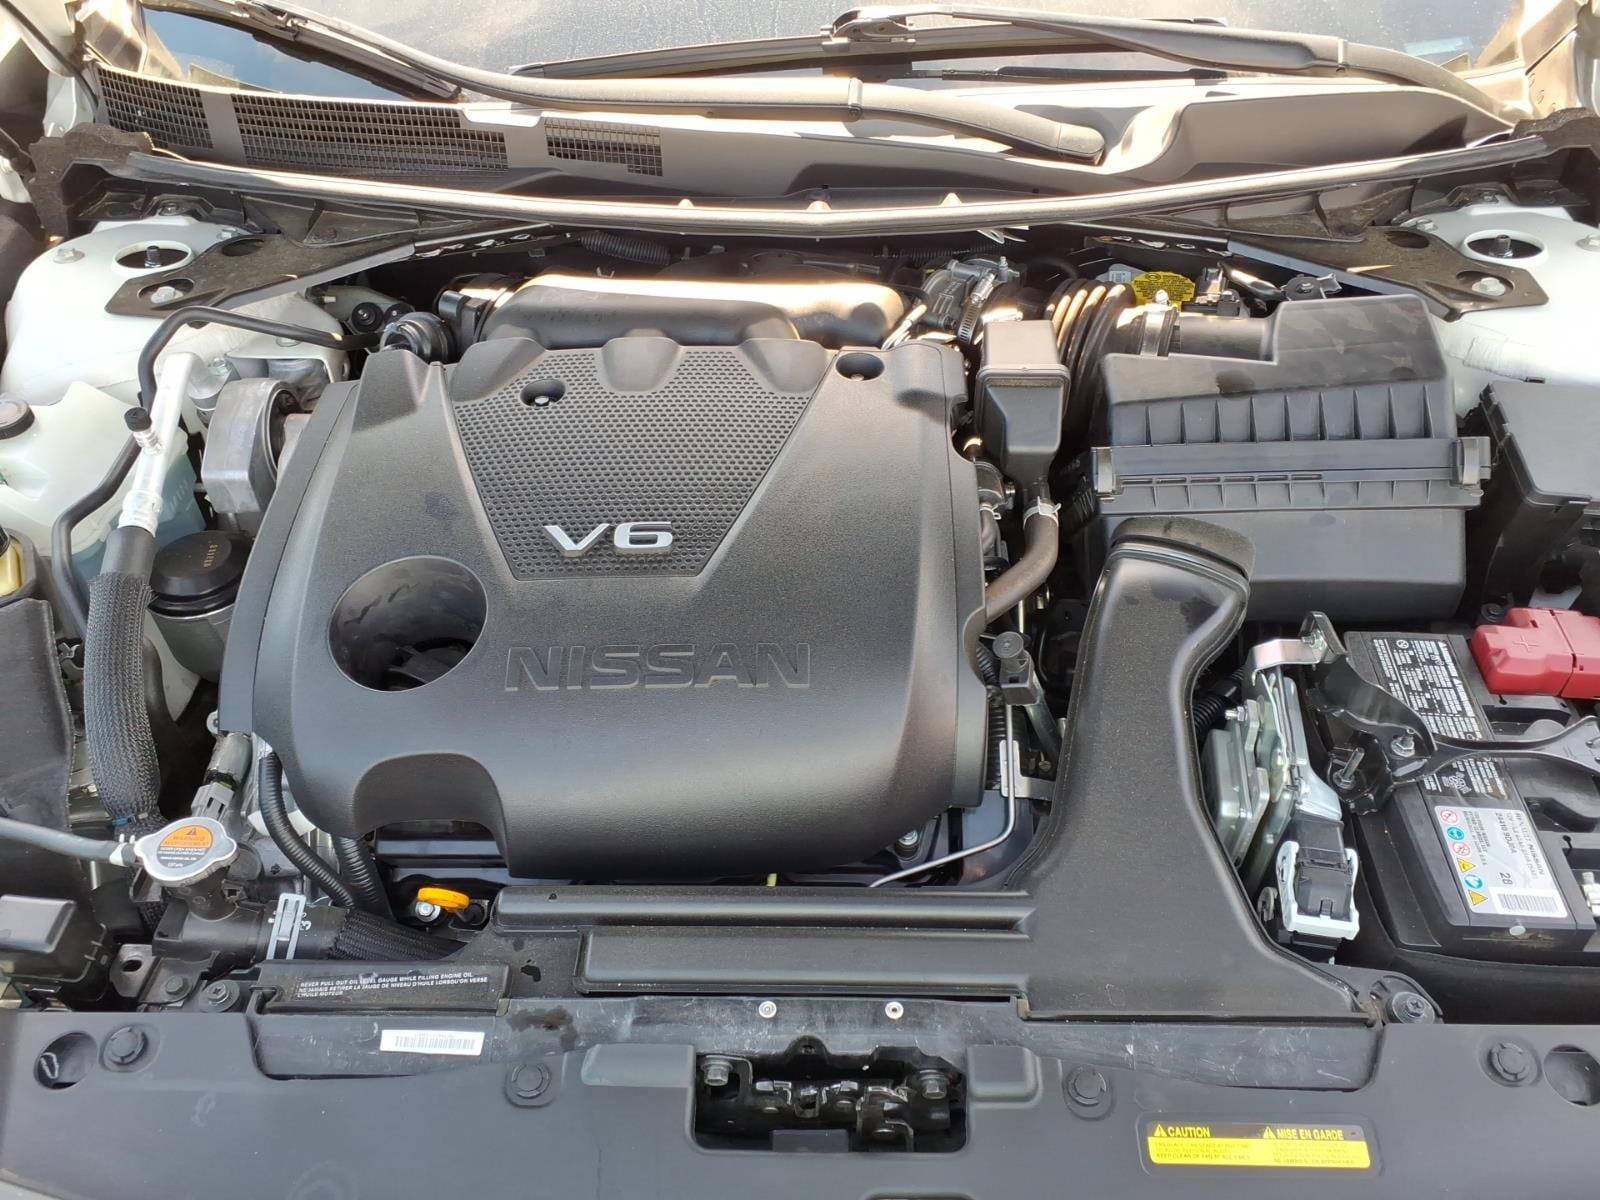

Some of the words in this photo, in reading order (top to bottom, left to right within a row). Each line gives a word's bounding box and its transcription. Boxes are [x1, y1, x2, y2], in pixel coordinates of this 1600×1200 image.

[542, 521, 673, 557] V6
[504, 642, 811, 691] NISSAN
[1528, 844, 1546, 875] NISSAN
[329, 984, 352, 992] RETIRER
[1167, 1126, 1211, 1138] CAUTION
[1276, 1127, 1298, 1140] MISE
[1299, 1128, 1312, 1140] EN
[1313, 1129, 1345, 1141] GARDE
